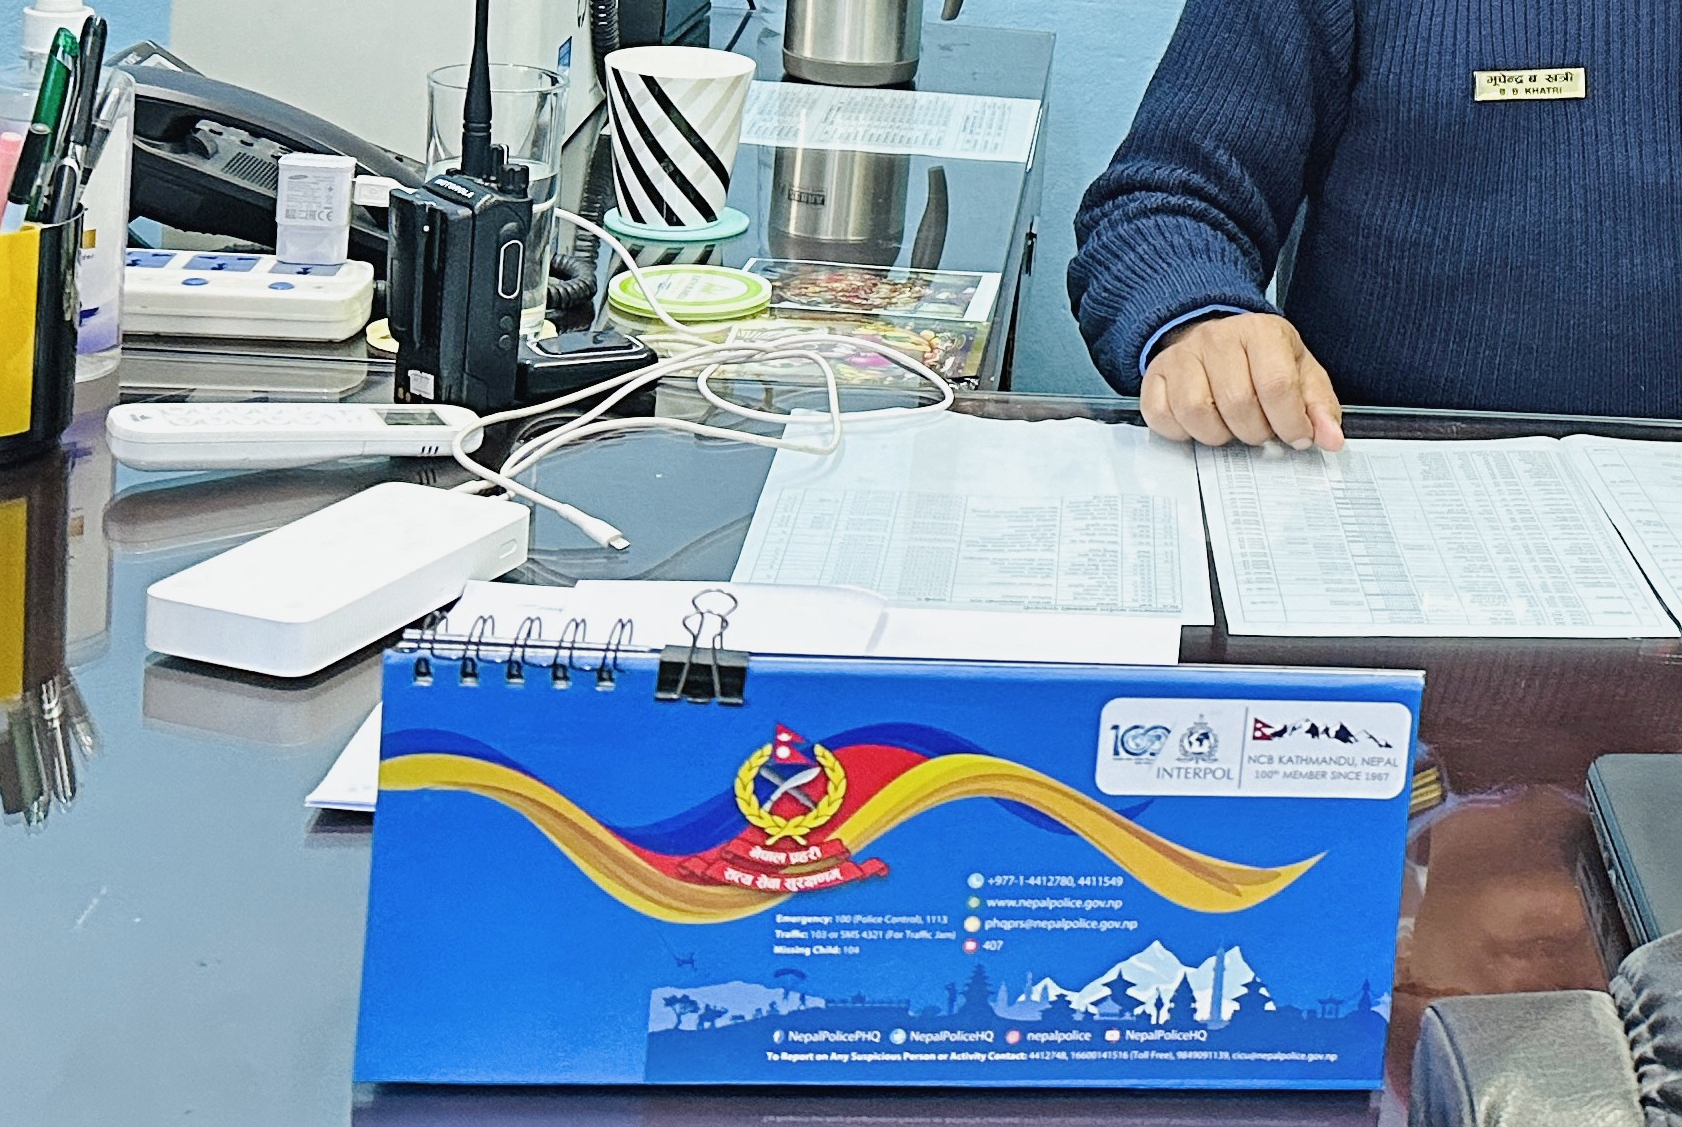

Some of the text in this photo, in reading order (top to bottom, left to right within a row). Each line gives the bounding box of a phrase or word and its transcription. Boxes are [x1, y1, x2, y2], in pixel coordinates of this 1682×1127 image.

[1524, 86, 1562, 95] KHATRI
[434, 178, 475, 199] MOTOROLA
[1247, 754, 1399, 768] NCB KATHMANDU, NEPAL
[1156, 766, 1234, 781] INTERPOL
[1282, 770, 1328, 780] MEMBER
[1330, 770, 1362, 781] SINCE
[987, 875, 1124, 888] +977-1-4412780, 4411549
[986, 897, 1123, 911] www.nepalpolice.gov.np
[775, 913, 833, 925] Emergency:
[984, 918, 1139, 932] phqprs@nepalpolice.gov.np
[774, 929, 809, 939] Traffic:
[840, 930, 860, 940] SMS
[773, 945, 811, 957] Missing
[812, 946, 842, 955] Child:
[982, 939, 1004, 951] 407
[788, 1029, 1208, 1044] NepalPolicePHQ NepalPoliceHQ nepalpolice NepalPoliceHQ
[766, 1051, 780, 1061] To
[780, 1051, 815, 1063] Report
[815, 1053, 829, 1061] on
[829, 1051, 850, 1063] Any
[850, 1052, 902, 1062] Suspicious
[902, 1052, 937, 1061] Person
[937, 1053, 949, 1061] or
[949, 1052, 987, 1063] Activity
[987, 1052, 1028, 1061] Contact:
